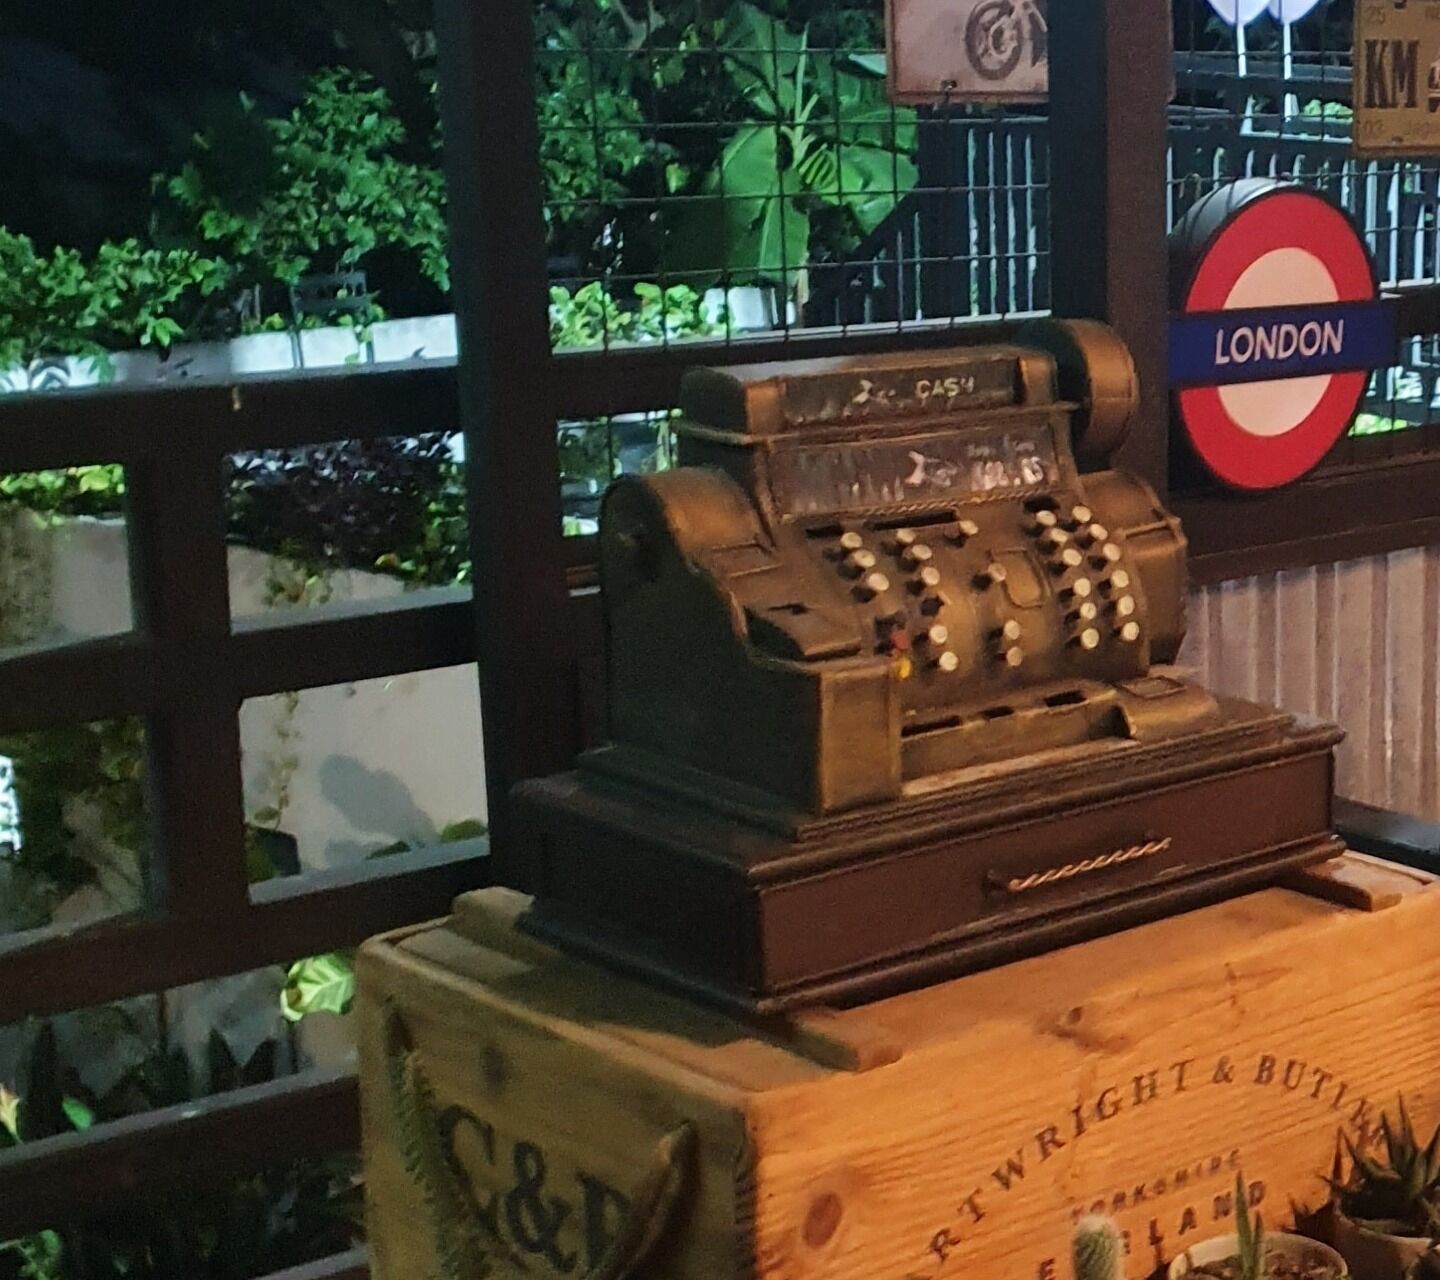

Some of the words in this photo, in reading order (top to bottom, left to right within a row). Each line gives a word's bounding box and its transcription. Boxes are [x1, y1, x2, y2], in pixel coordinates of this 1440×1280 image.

[1364, 38, 1420, 109] KM
[1214, 319, 1346, 366] LONDON
[914, 375, 976, 400] CASH
[1070, 1148, 1240, 1224] YORKSHIRE
